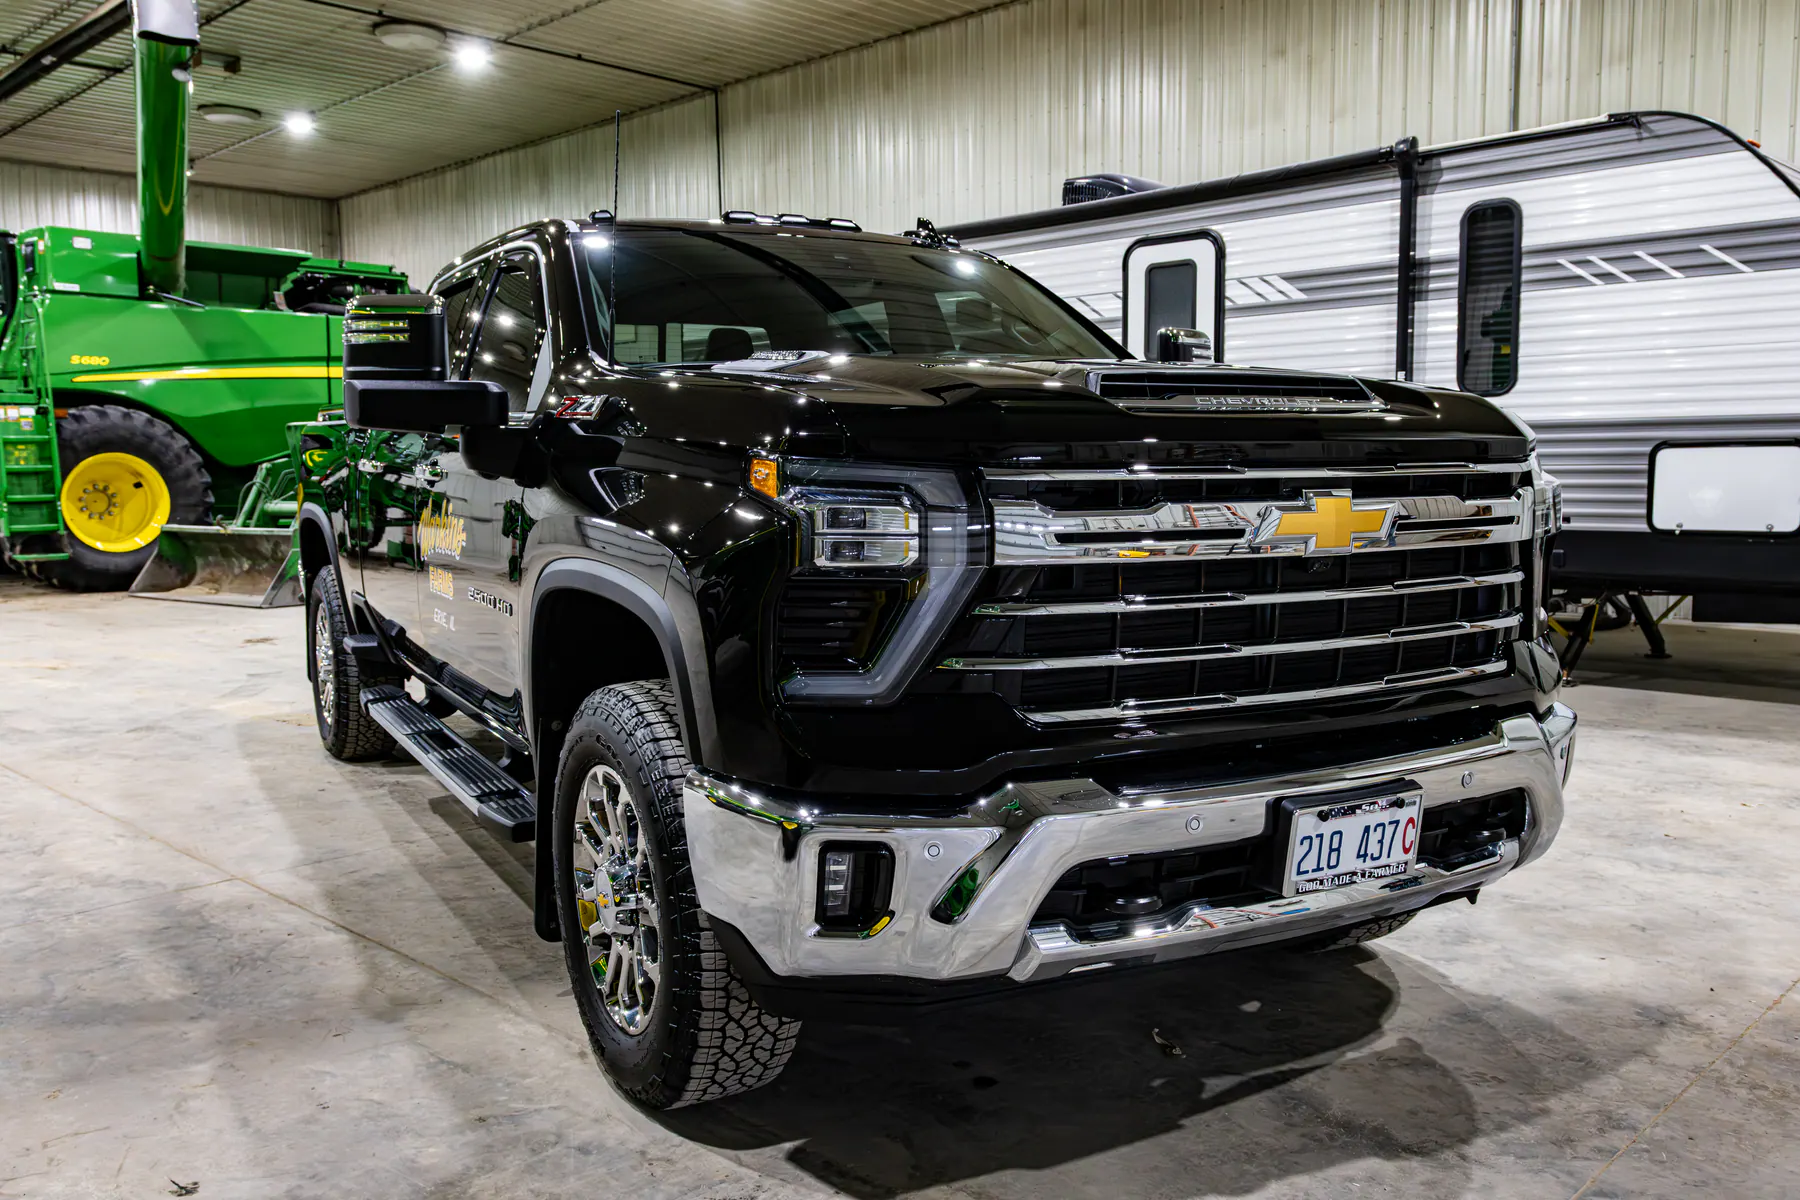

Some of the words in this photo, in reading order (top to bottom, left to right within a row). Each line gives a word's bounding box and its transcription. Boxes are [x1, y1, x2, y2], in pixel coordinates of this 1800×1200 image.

[70, 354, 110, 366] S680
[555, 394, 608, 420] Z71
[1194, 396, 1320, 407] CHEVROLET
[429, 564, 454, 600] FARMS
[468, 586, 497, 609] 2500
[497, 599, 514, 617] HD
[1296, 830, 1344, 877] 218
[1298, 881, 1320, 893] GOD
[1323, 873, 1353, 889] MADE
[1355, 871, 1363, 881] A
[1365, 862, 1406, 879] FARMER
